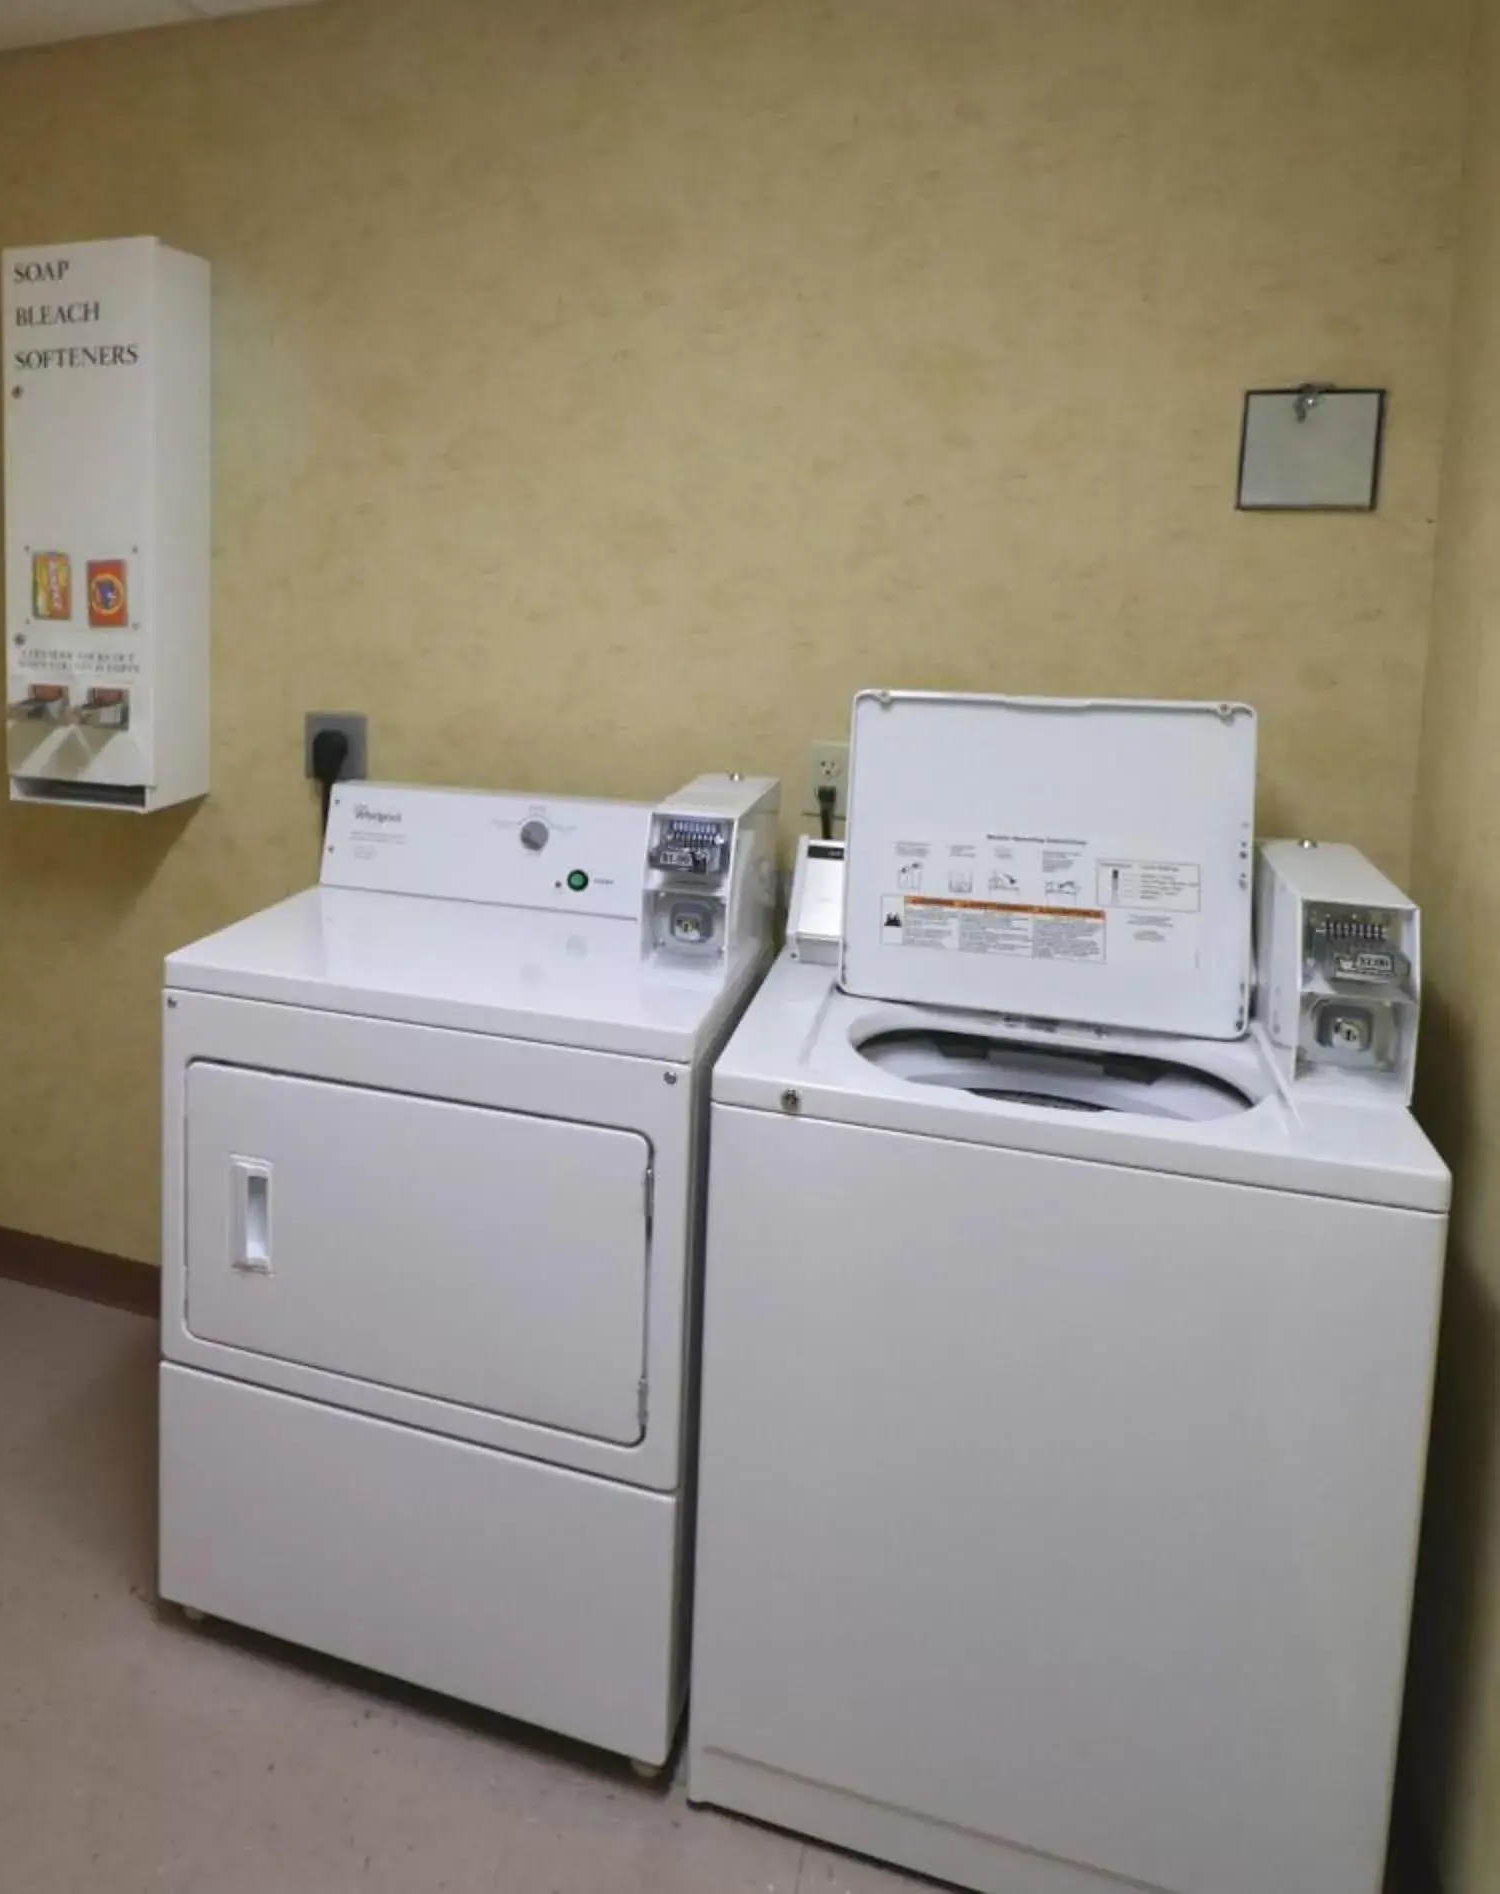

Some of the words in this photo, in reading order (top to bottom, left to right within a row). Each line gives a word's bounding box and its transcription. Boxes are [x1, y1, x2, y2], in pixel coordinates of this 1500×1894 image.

[13, 259, 70, 284] SOAP
[15, 301, 100, 327] BLEACH
[13, 343, 139, 370] SOFTENERS
